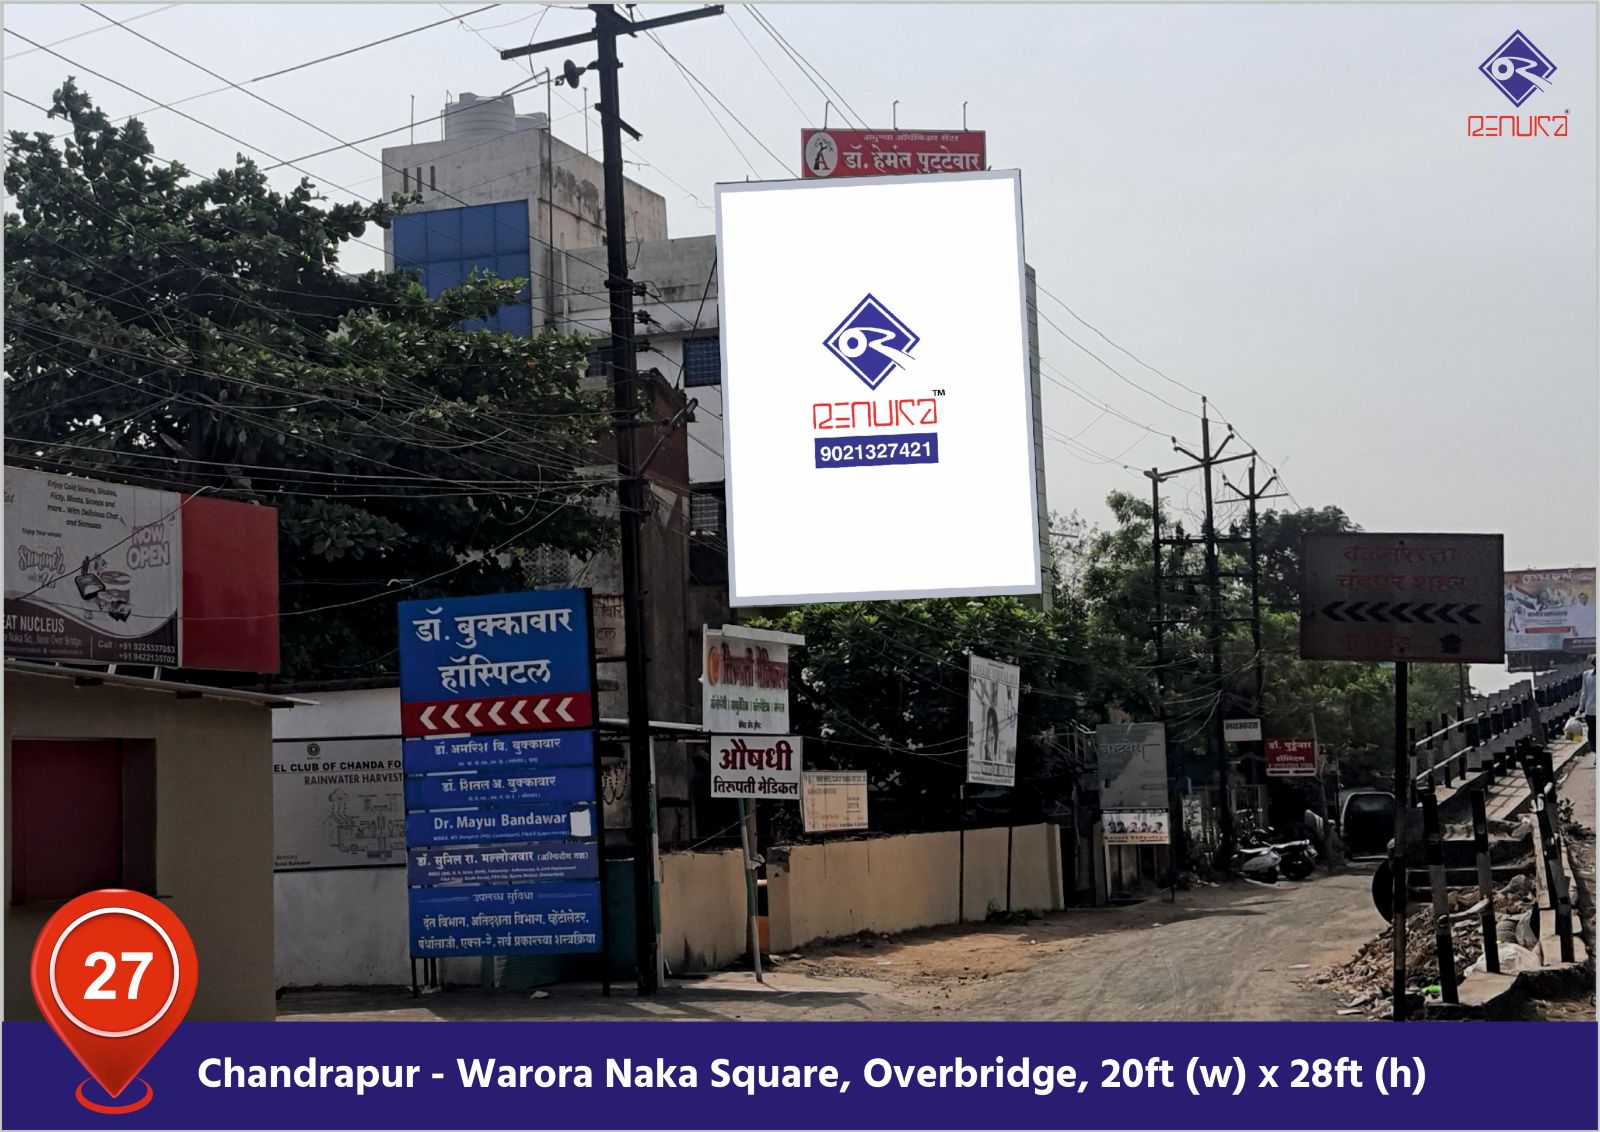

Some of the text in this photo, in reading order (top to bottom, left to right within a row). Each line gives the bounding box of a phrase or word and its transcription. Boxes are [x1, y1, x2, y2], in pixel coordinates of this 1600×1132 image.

[843, 144, 868, 169] डॉ.
[871, 144, 912, 173] हेमंत
[932, 389, 946, 397] TM
[820, 441, 931, 462] 9021327421
[132, 525, 164, 545] NOW
[127, 542, 170, 570] OPEN
[20, 615, 65, 633] NUCLEUS
[412, 606, 573, 649] डॉ. बुक्कावार
[98, 640, 113, 649] Call
[438, 653, 551, 694] हॉस्पिटल
[434, 740, 449, 755] डॉ.
[450, 740, 488, 754] अमरिश
[512, 738, 561, 755] बुक्कावार
[719, 738, 793, 772] औषधी
[274, 760, 402, 773] EL CLUB OF CHANDA FO
[304, 772, 403, 786] RAINWATER HARVEST
[441, 778, 456, 792] डॉ.
[459, 777, 489, 792] शितल
[508, 776, 556, 794] बुक्कावार
[758, 776, 799, 796] मेडिकल
[434, 817, 454, 830] Dr.
[501, 811, 568, 827] Bandawar
[416, 855, 431, 867] डॉ.
[434, 852, 462, 870] सुनिल
[481, 849, 533, 863] मल्लोजवार
[507, 889, 533, 904] सुविधा
